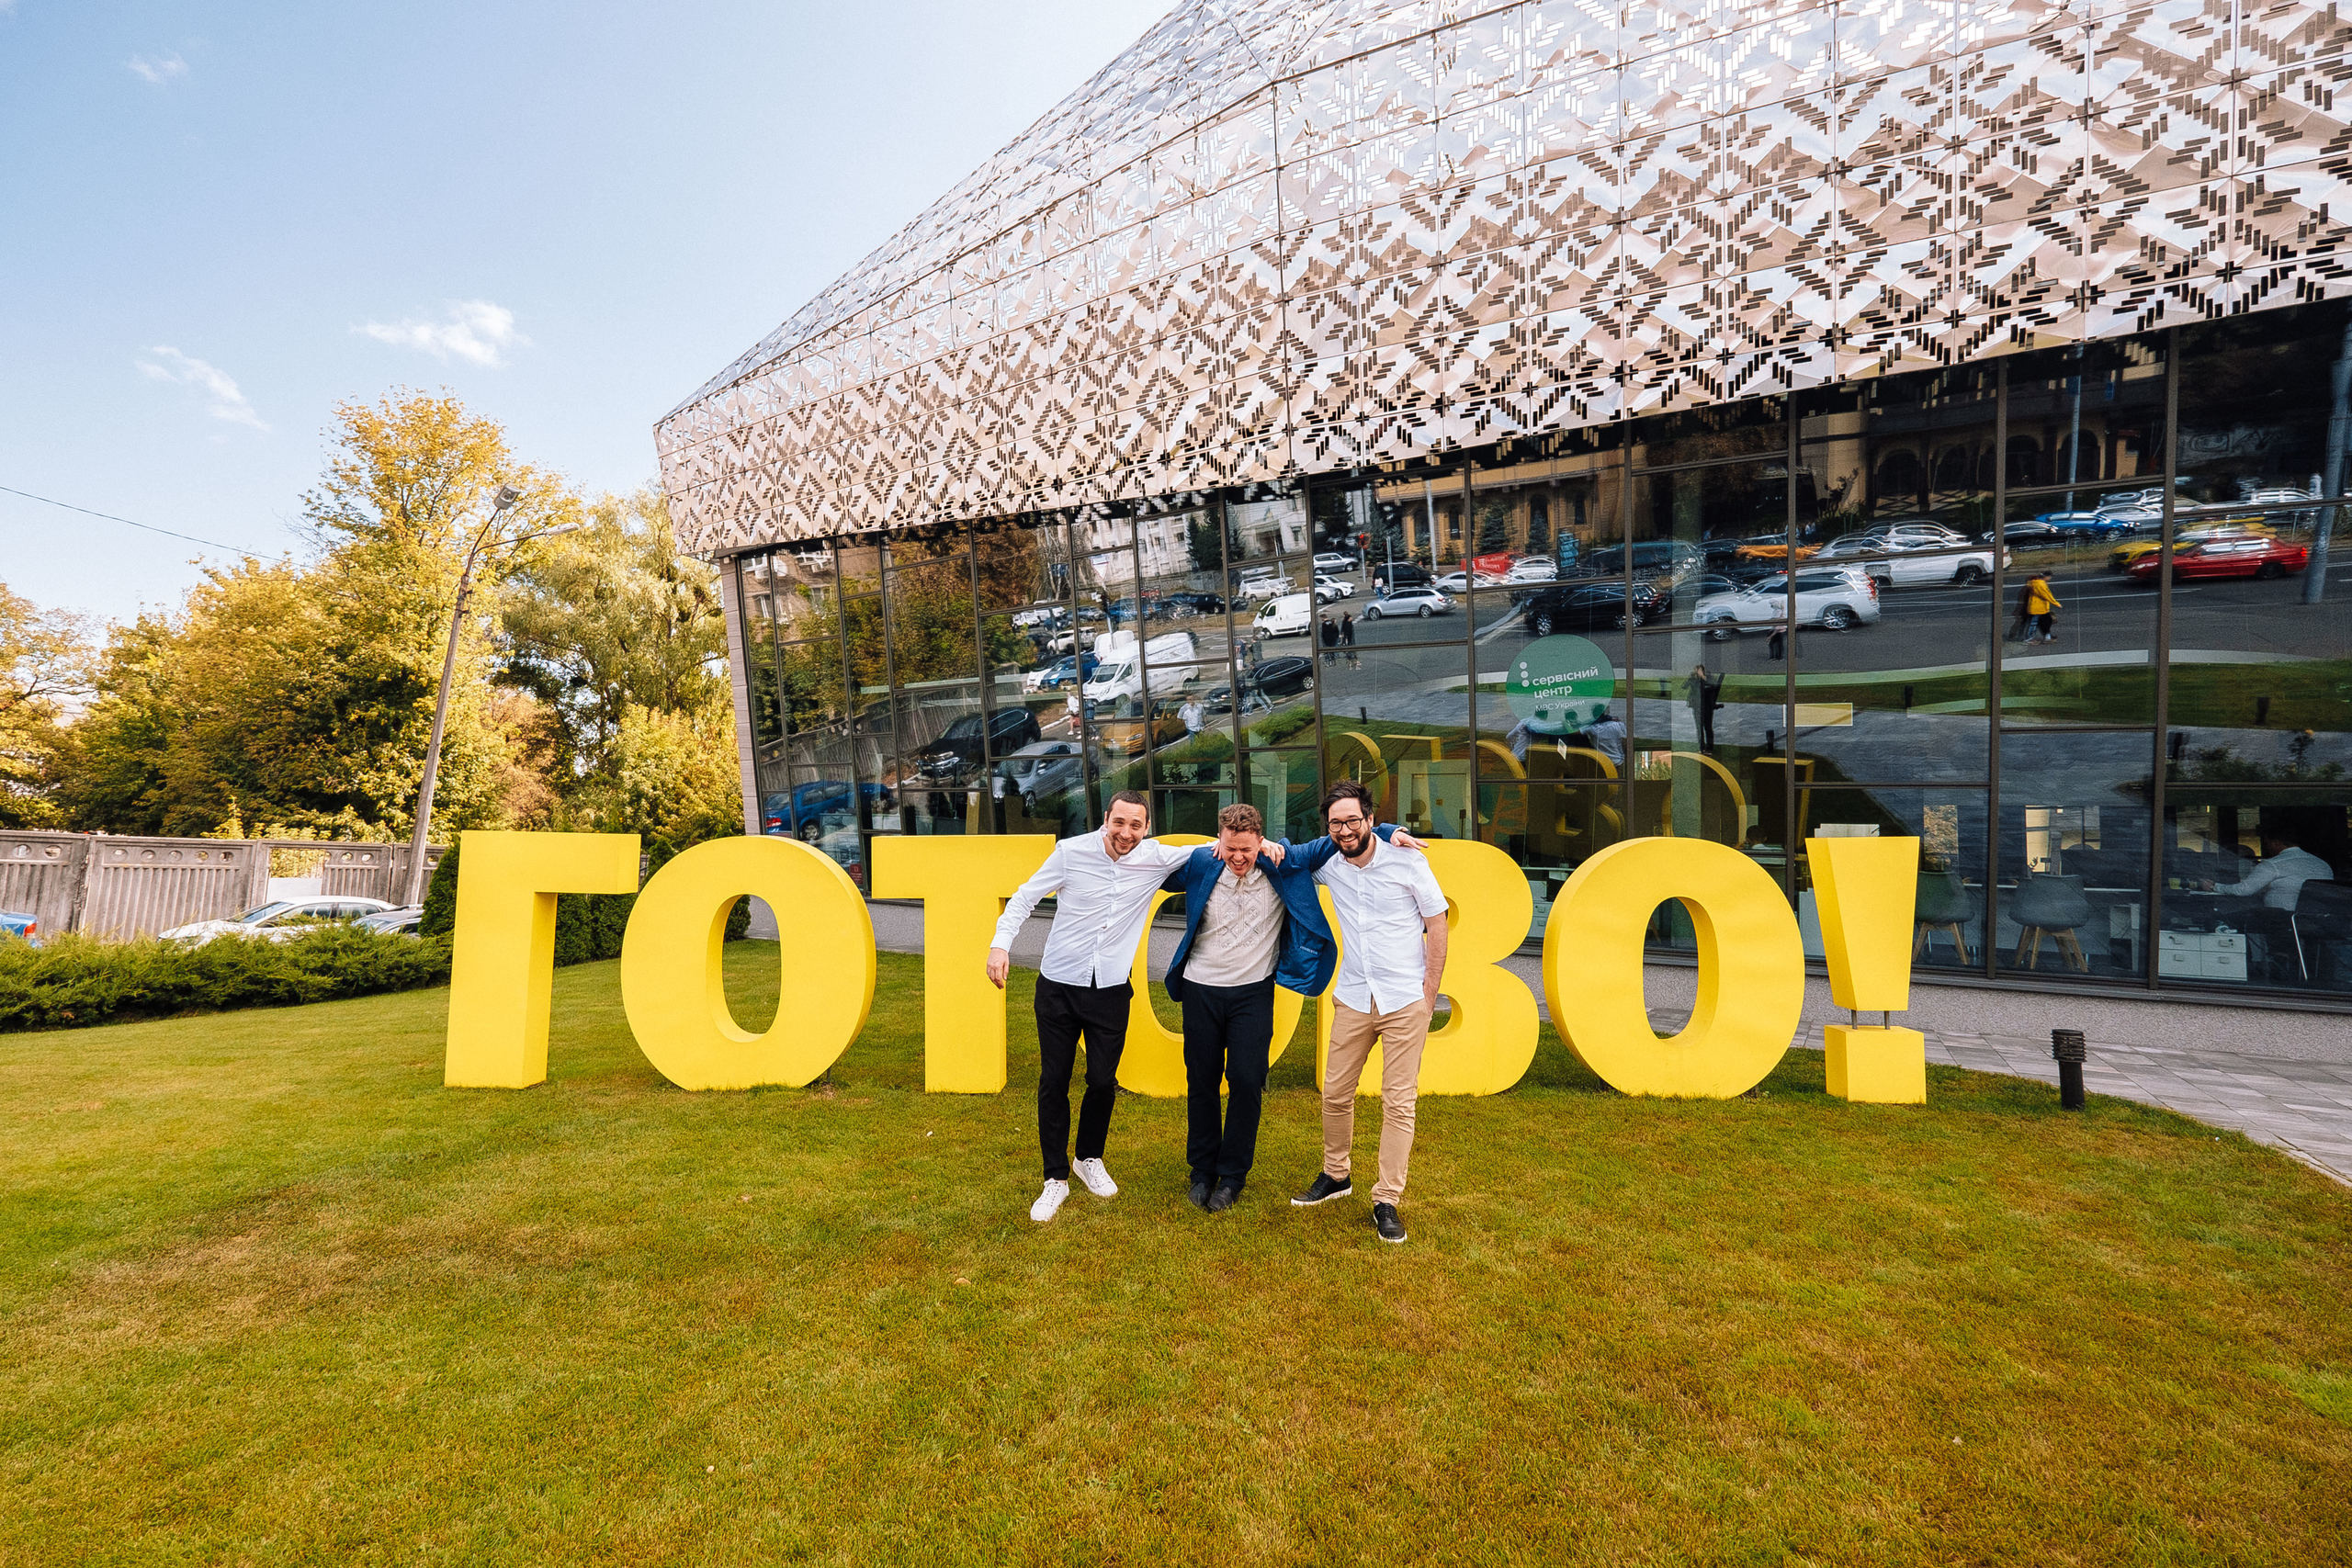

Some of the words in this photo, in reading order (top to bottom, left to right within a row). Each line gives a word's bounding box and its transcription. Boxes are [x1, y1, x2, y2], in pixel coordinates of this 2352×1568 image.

[1532, 665, 1599, 686] сервісний
[1533, 684, 1573, 699] центр
[1535, 703, 1555, 712] МВС
[1555, 699, 1586, 710] України
